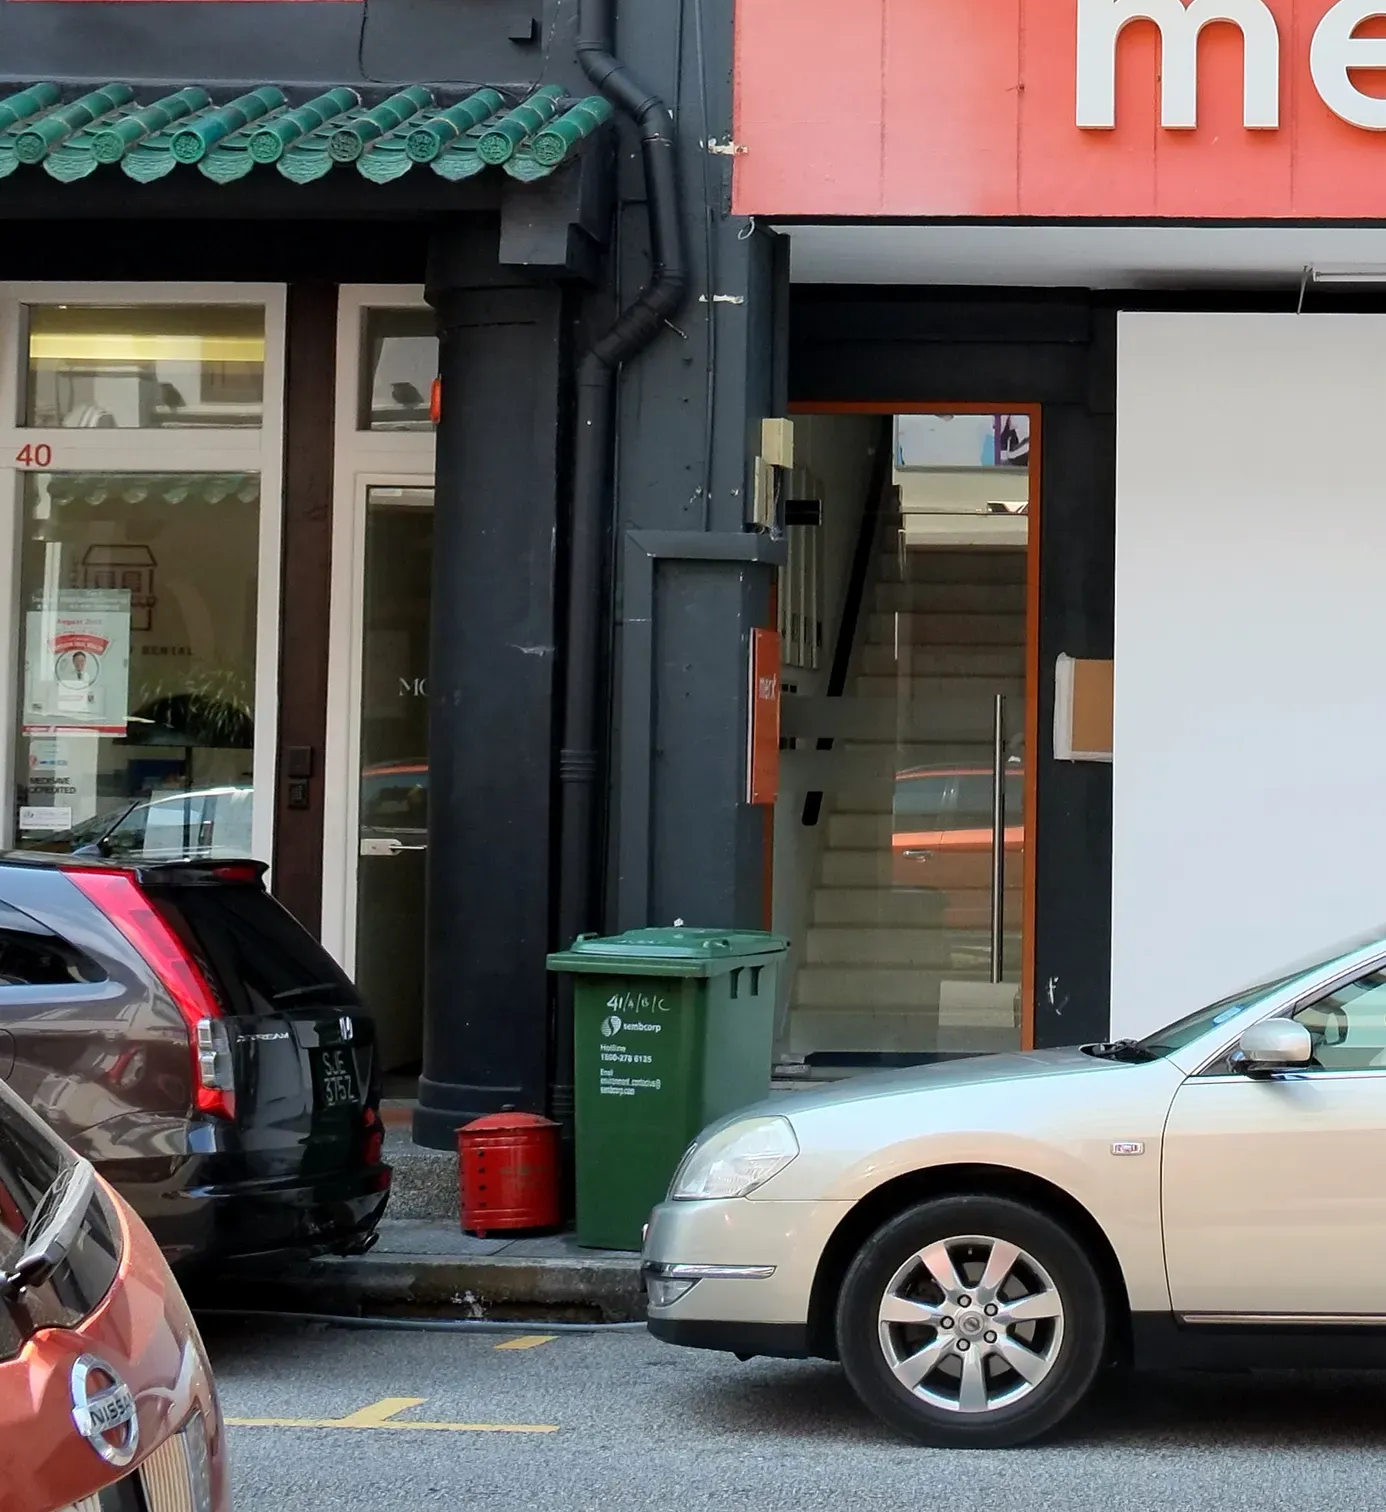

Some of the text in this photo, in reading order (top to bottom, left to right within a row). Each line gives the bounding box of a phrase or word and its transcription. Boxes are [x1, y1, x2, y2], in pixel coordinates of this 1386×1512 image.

[15, 443, 52, 467] 40
[25, 786, 77, 794] CCREDITED
[623, 1022, 662, 1033] sembcorp
